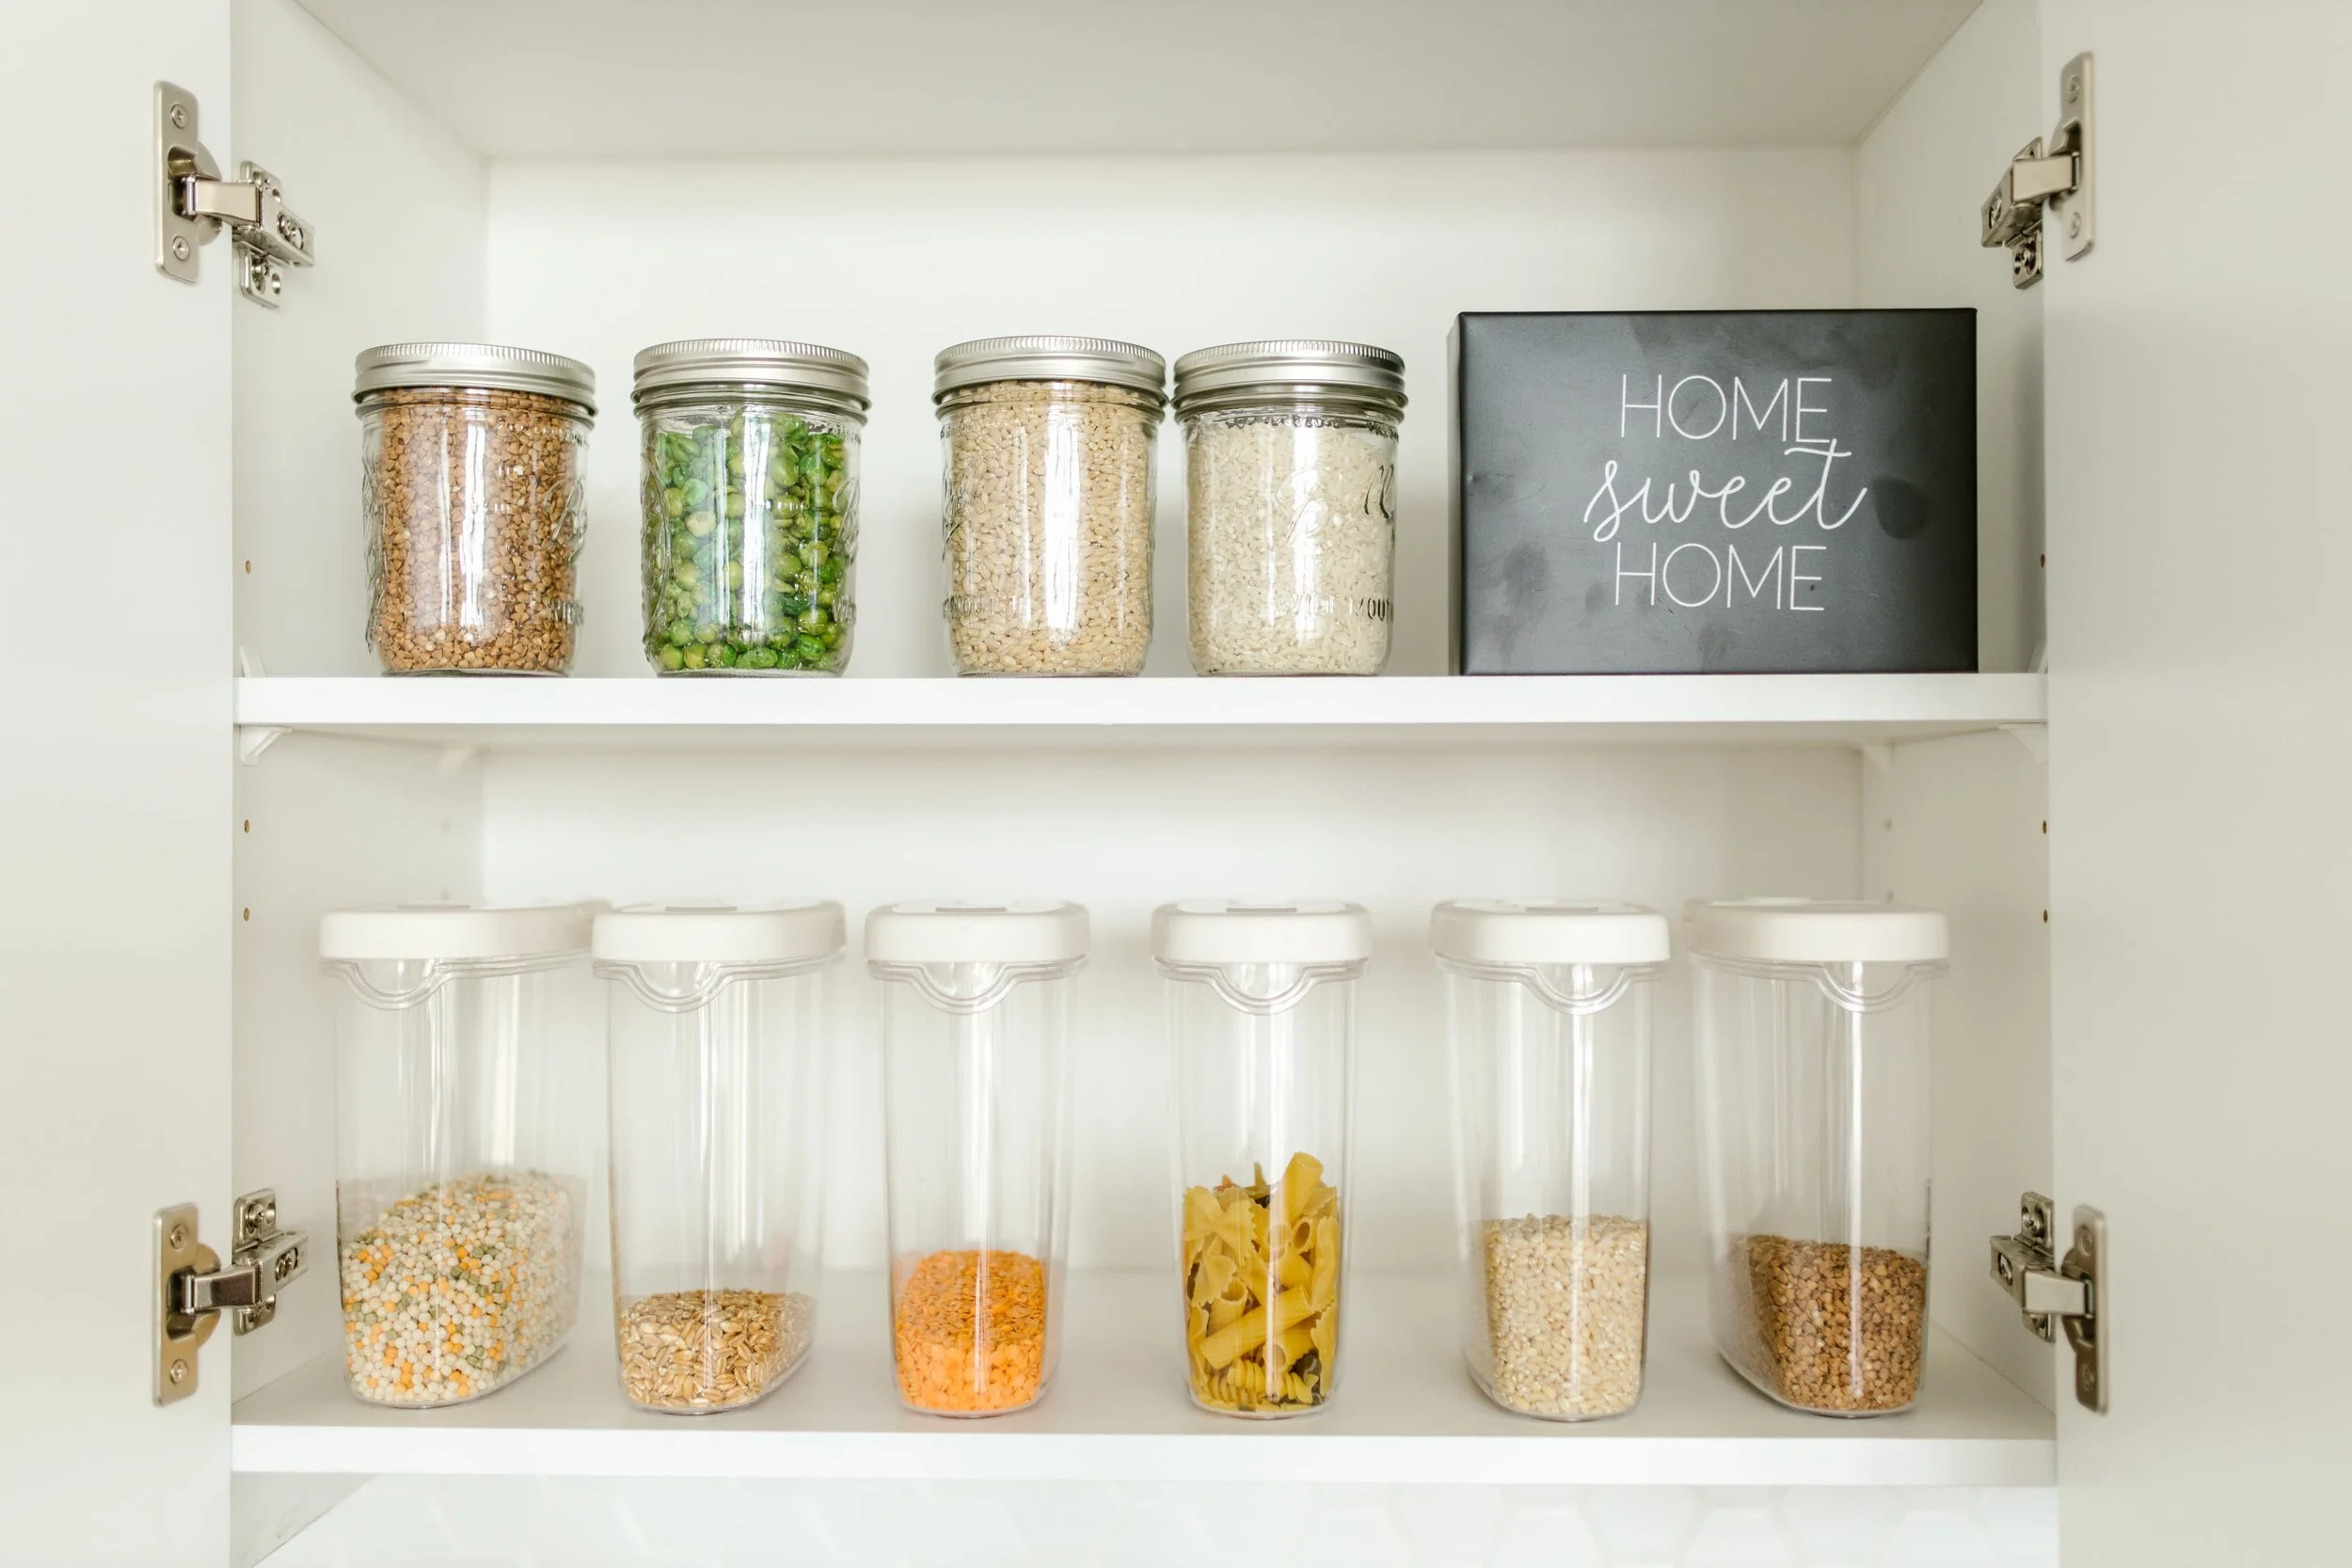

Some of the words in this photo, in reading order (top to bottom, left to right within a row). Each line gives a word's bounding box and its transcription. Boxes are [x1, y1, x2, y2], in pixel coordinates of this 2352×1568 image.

[1620, 373, 1834, 444] HOME
[1583, 437, 1868, 543] sweet
[1614, 542, 1828, 611] HOME
